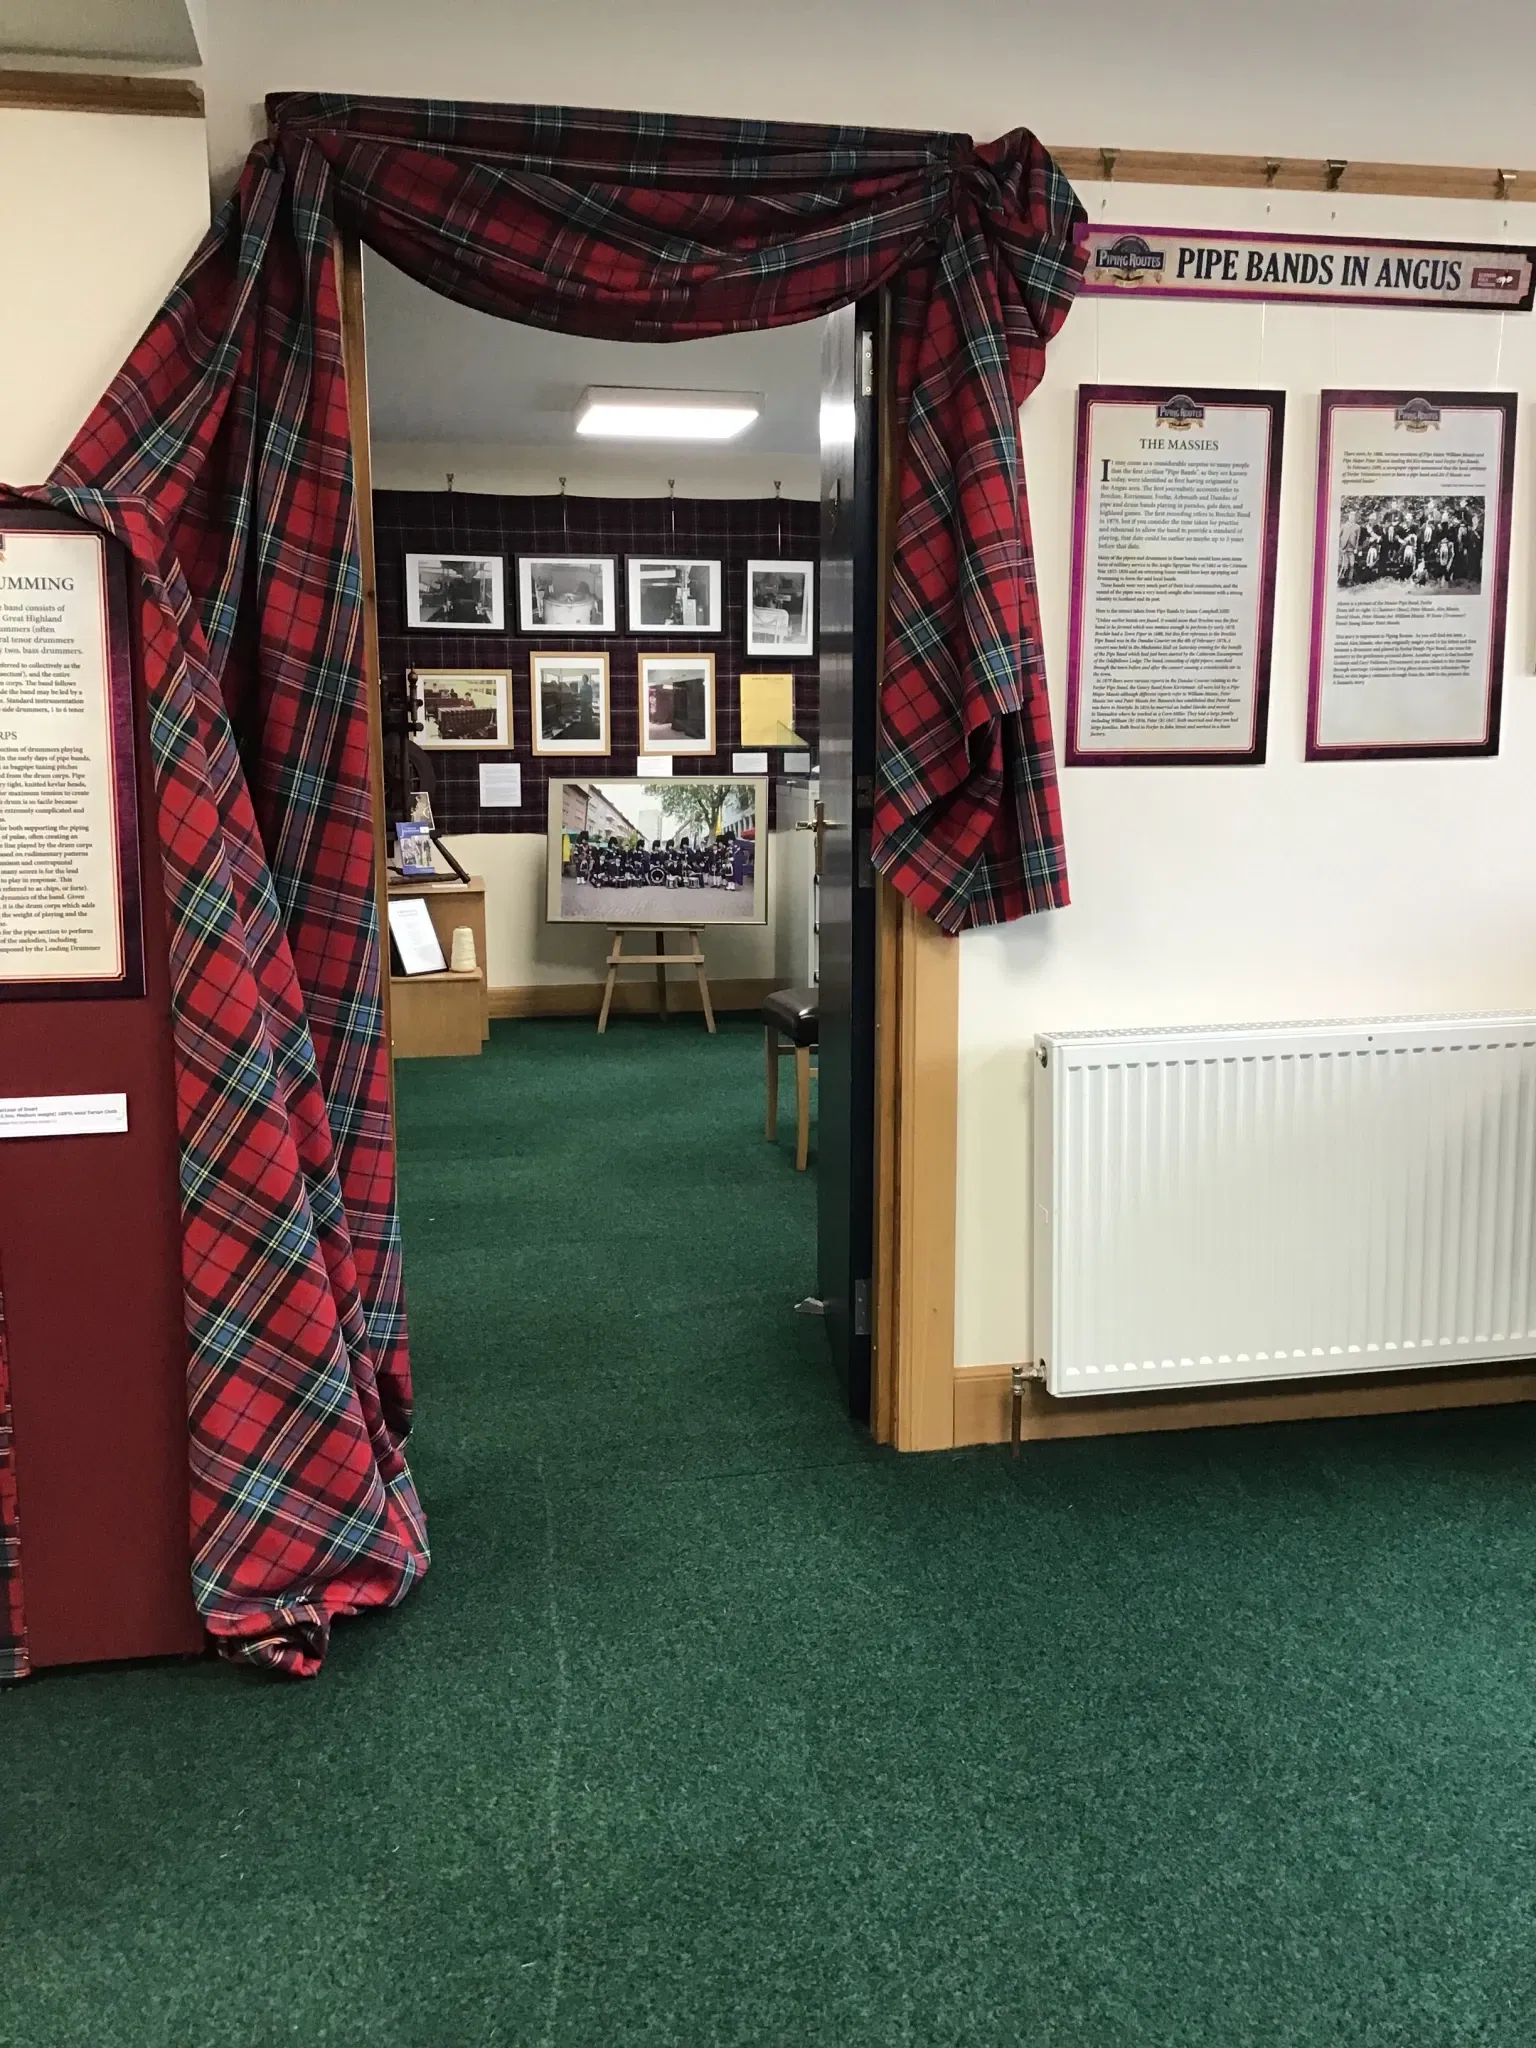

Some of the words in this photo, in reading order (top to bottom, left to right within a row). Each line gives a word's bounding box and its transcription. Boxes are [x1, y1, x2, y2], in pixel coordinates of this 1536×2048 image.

[1099, 249, 1128, 266] PIPING
[1129, 253, 1161, 268] ROUTES
[1176, 247, 1240, 281] PIPE
[1245, 251, 1334, 286] BANDS
[1340, 255, 1371, 287] IN
[1375, 257, 1463, 292] ANGUS
[1139, 438, 1165, 450] THE
[1167, 439, 1220, 451] MASSIES
[3, 603, 23, 611] band
[26, 614, 62, 623] Highland
[32, 626, 55, 634] (often
